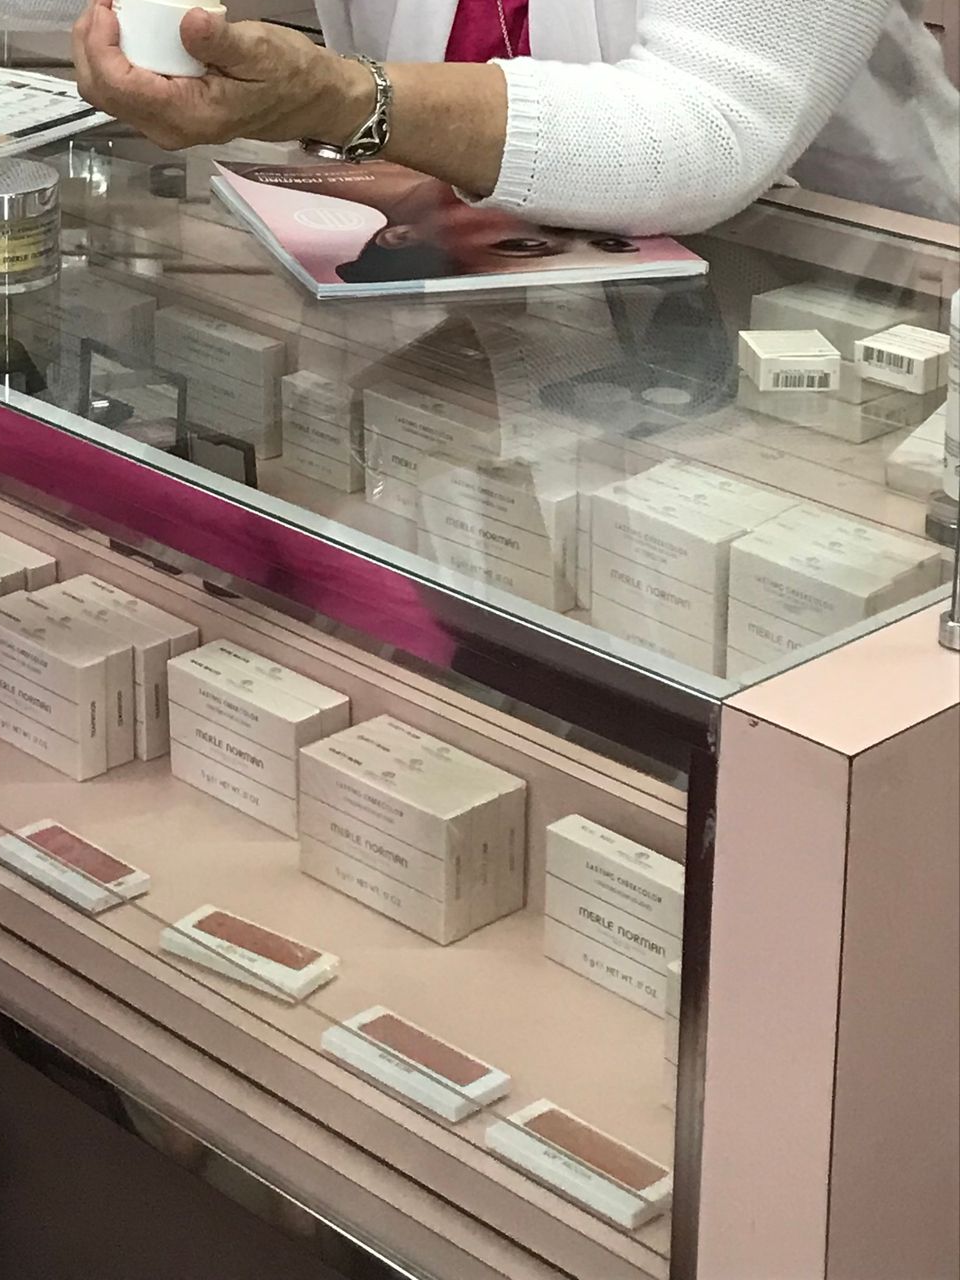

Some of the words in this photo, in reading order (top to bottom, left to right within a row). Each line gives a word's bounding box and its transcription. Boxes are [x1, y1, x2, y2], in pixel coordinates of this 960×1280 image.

[478, 528, 520, 551] NORMAN
[610, 569, 643, 591] MERLE
[747, 622, 783, 648] MERLE
[195, 728, 224, 750] MERLE
[226, 742, 264, 769] NORMAN
[330, 822, 362, 847] MERLE
[364, 839, 408, 869] NORMAN
[578, 906, 614, 932] MERLE
[617, 925, 667, 958] NORMAN
